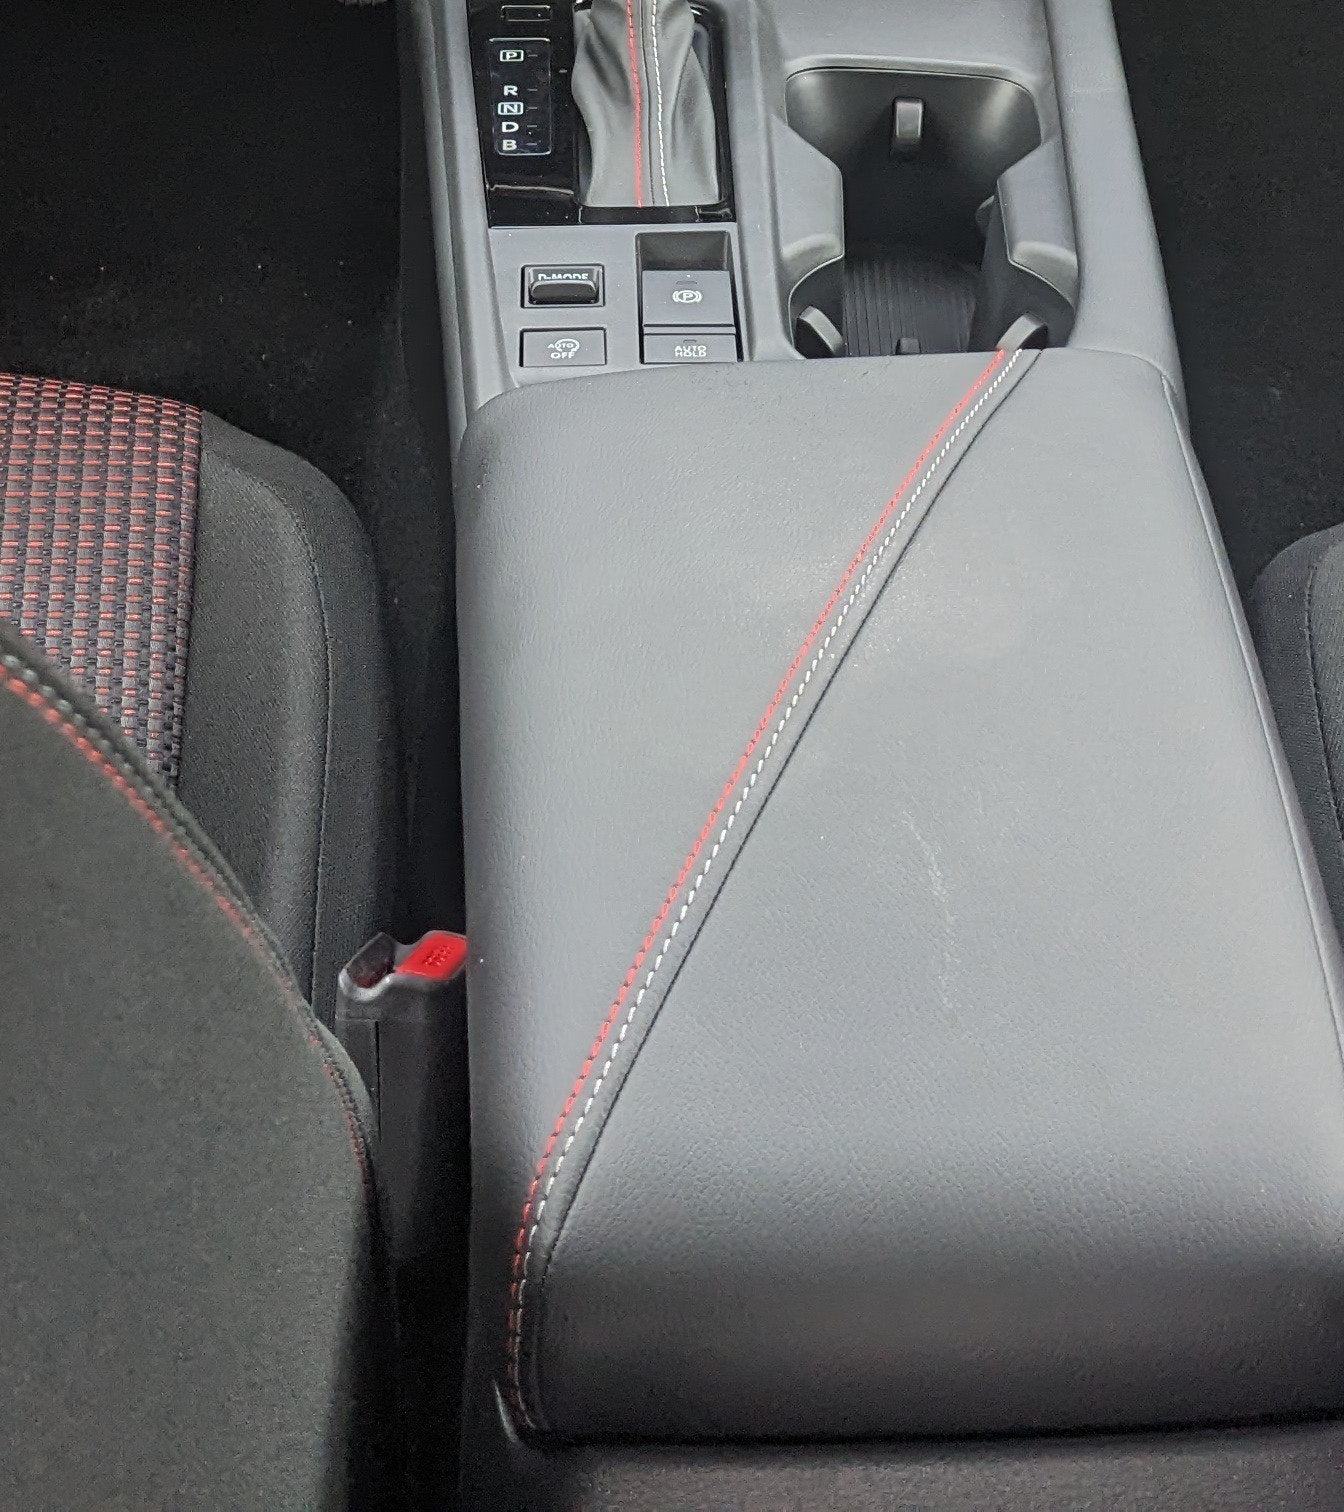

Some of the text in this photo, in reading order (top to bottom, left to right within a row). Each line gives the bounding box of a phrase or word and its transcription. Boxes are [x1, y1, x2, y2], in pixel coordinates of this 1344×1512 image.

[505, 51, 518, 61] P
[503, 85, 518, 96] R
[502, 103, 519, 114] N
[502, 122, 518, 132] D
[502, 140, 516, 150] B
